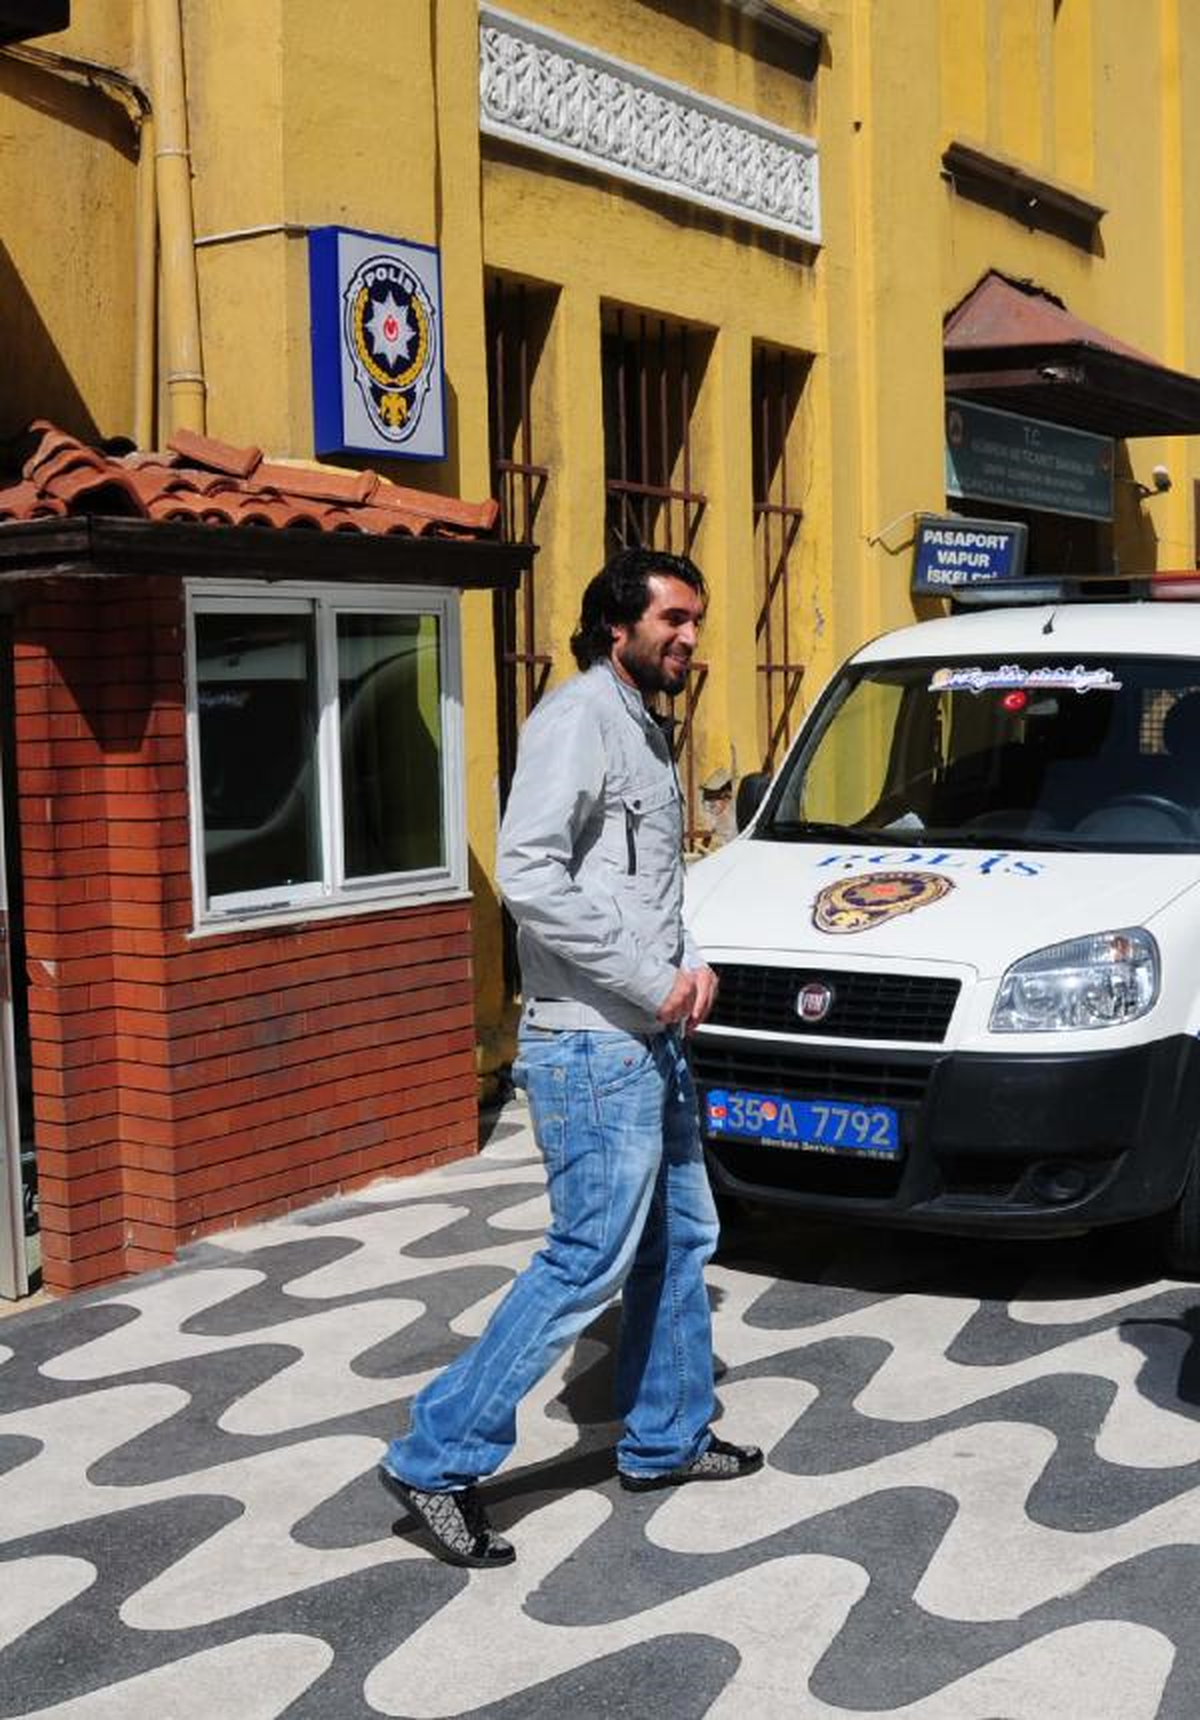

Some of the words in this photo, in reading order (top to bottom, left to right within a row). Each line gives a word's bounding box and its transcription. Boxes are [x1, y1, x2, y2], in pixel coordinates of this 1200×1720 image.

[364, 266, 413, 294] POLİS
[923, 530, 1009, 550] PASAPORT
[937, 550, 990, 568] VAPUR
[927, 565, 998, 584] İSKEL
[727, 1097, 765, 1131] 35
[776, 1103, 798, 1136] A
[811, 1106, 891, 1145] 7792
